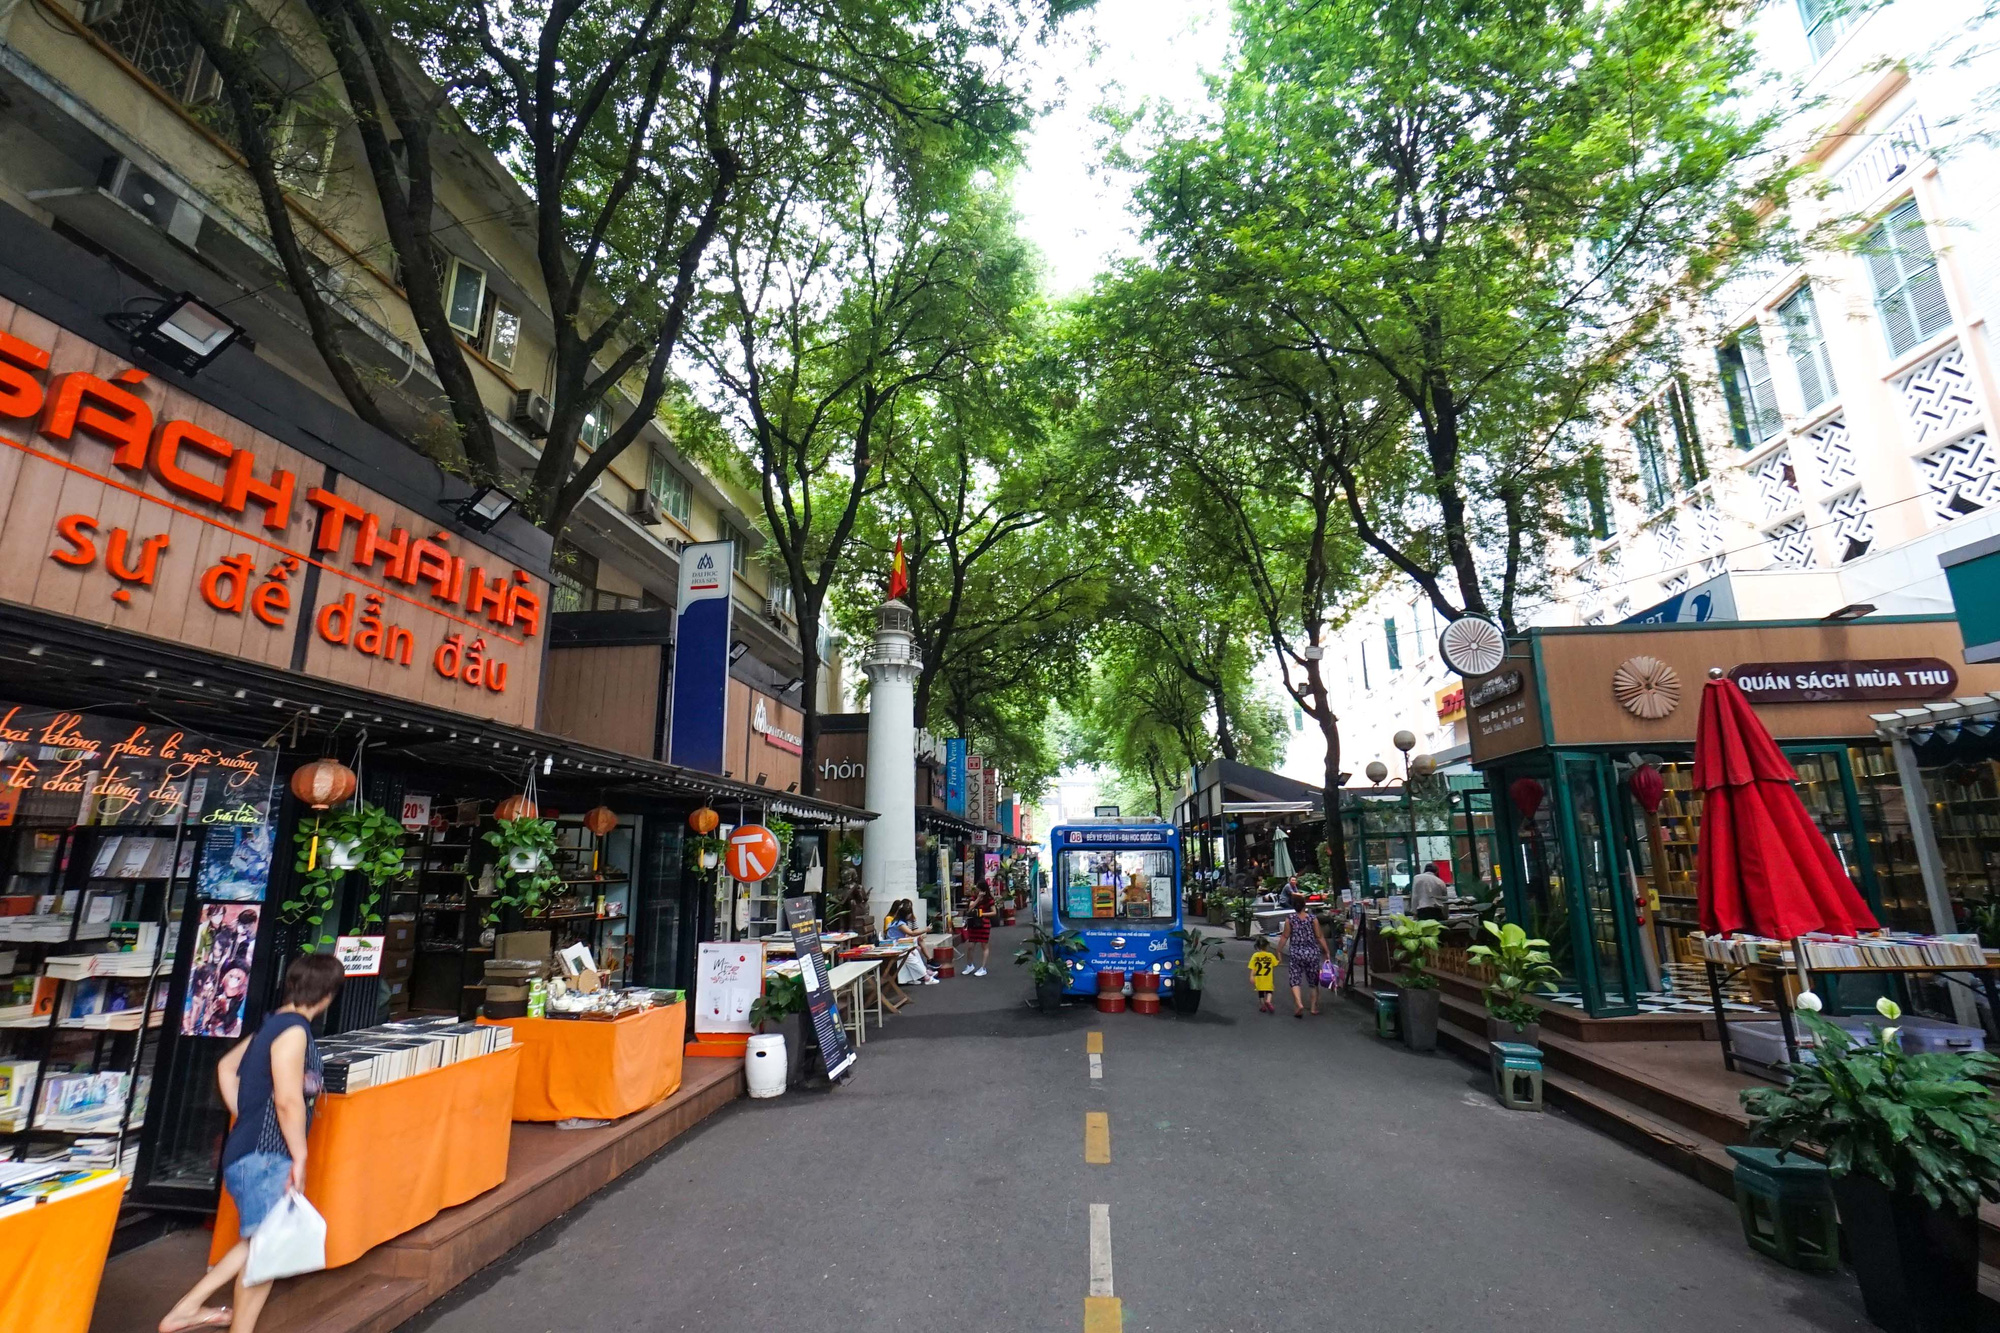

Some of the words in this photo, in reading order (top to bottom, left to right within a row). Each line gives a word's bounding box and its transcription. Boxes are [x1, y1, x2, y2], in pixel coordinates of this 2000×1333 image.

[307, 488, 464, 605] THÁI
[466, 569, 540, 638] HÀ
[50, 514, 169, 603] sự
[200, 553, 299, 627] để
[316, 593, 415, 667] dẫn
[434, 634, 508, 695] đầu
[1738, 673, 1791, 693] QUÁN
[1795, 670, 1850, 690] SÁCH
[1855, 669, 1902, 688] MÙA
[1904, 670, 1950, 686] THU
[40, 713, 101, 763] không
[160, 732, 185, 759] là
[166, 749, 207, 778] ngã
[948, 741, 957, 765] News
[217, 750, 260, 788] xuống
[948, 766, 957, 786] First
[148, 774, 188, 818] dậy
[1148, 938, 1168, 951] Sách
[1254, 961, 1271, 976] 23
